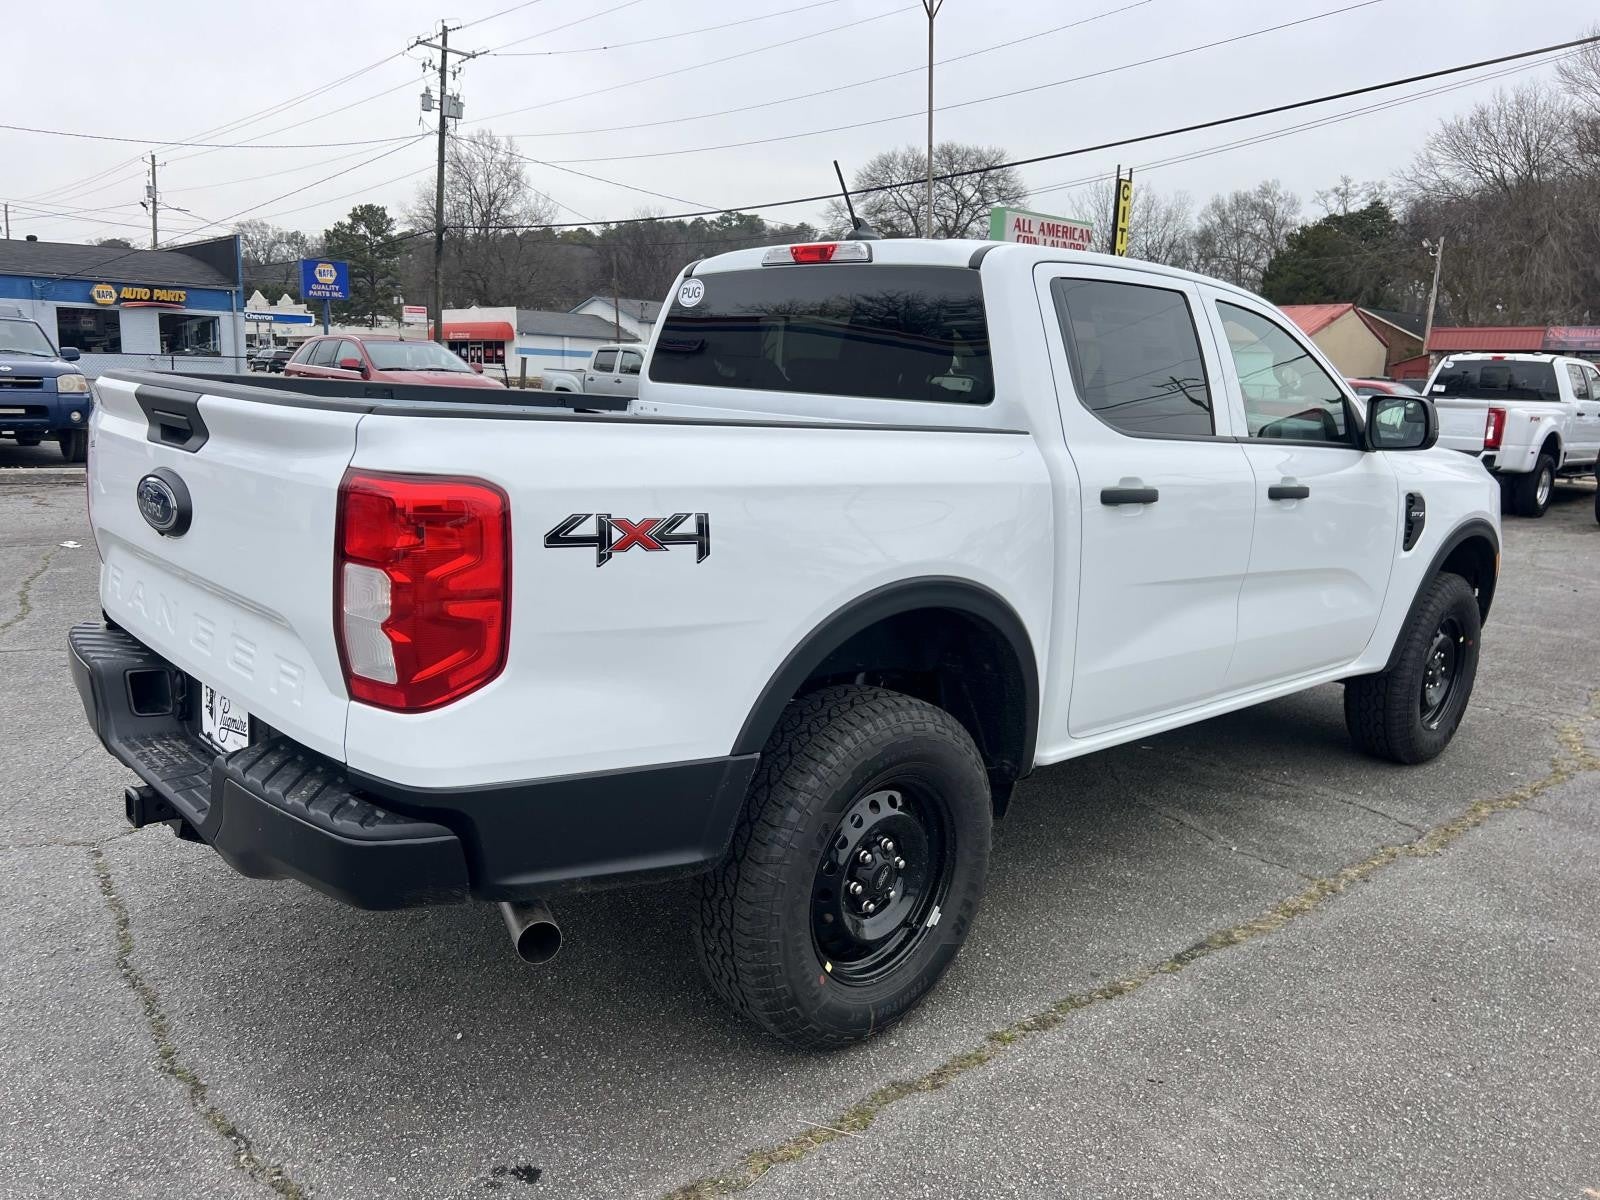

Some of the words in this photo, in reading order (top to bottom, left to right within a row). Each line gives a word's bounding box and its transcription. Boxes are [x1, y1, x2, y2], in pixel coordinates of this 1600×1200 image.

[1013, 217, 1034, 234] ALL
[1038, 221, 1094, 244] AMERICAN
[318, 268, 334, 279] NAPA
[311, 283, 340, 291] QUALITY
[681, 286, 702, 299] PUG
[95, 289, 114, 300] NAPA
[120, 287, 151, 300] AUTO
[153, 288, 187, 302] PARTS
[245, 312, 274, 321] Chevron
[108, 563, 305, 708] RANGER
